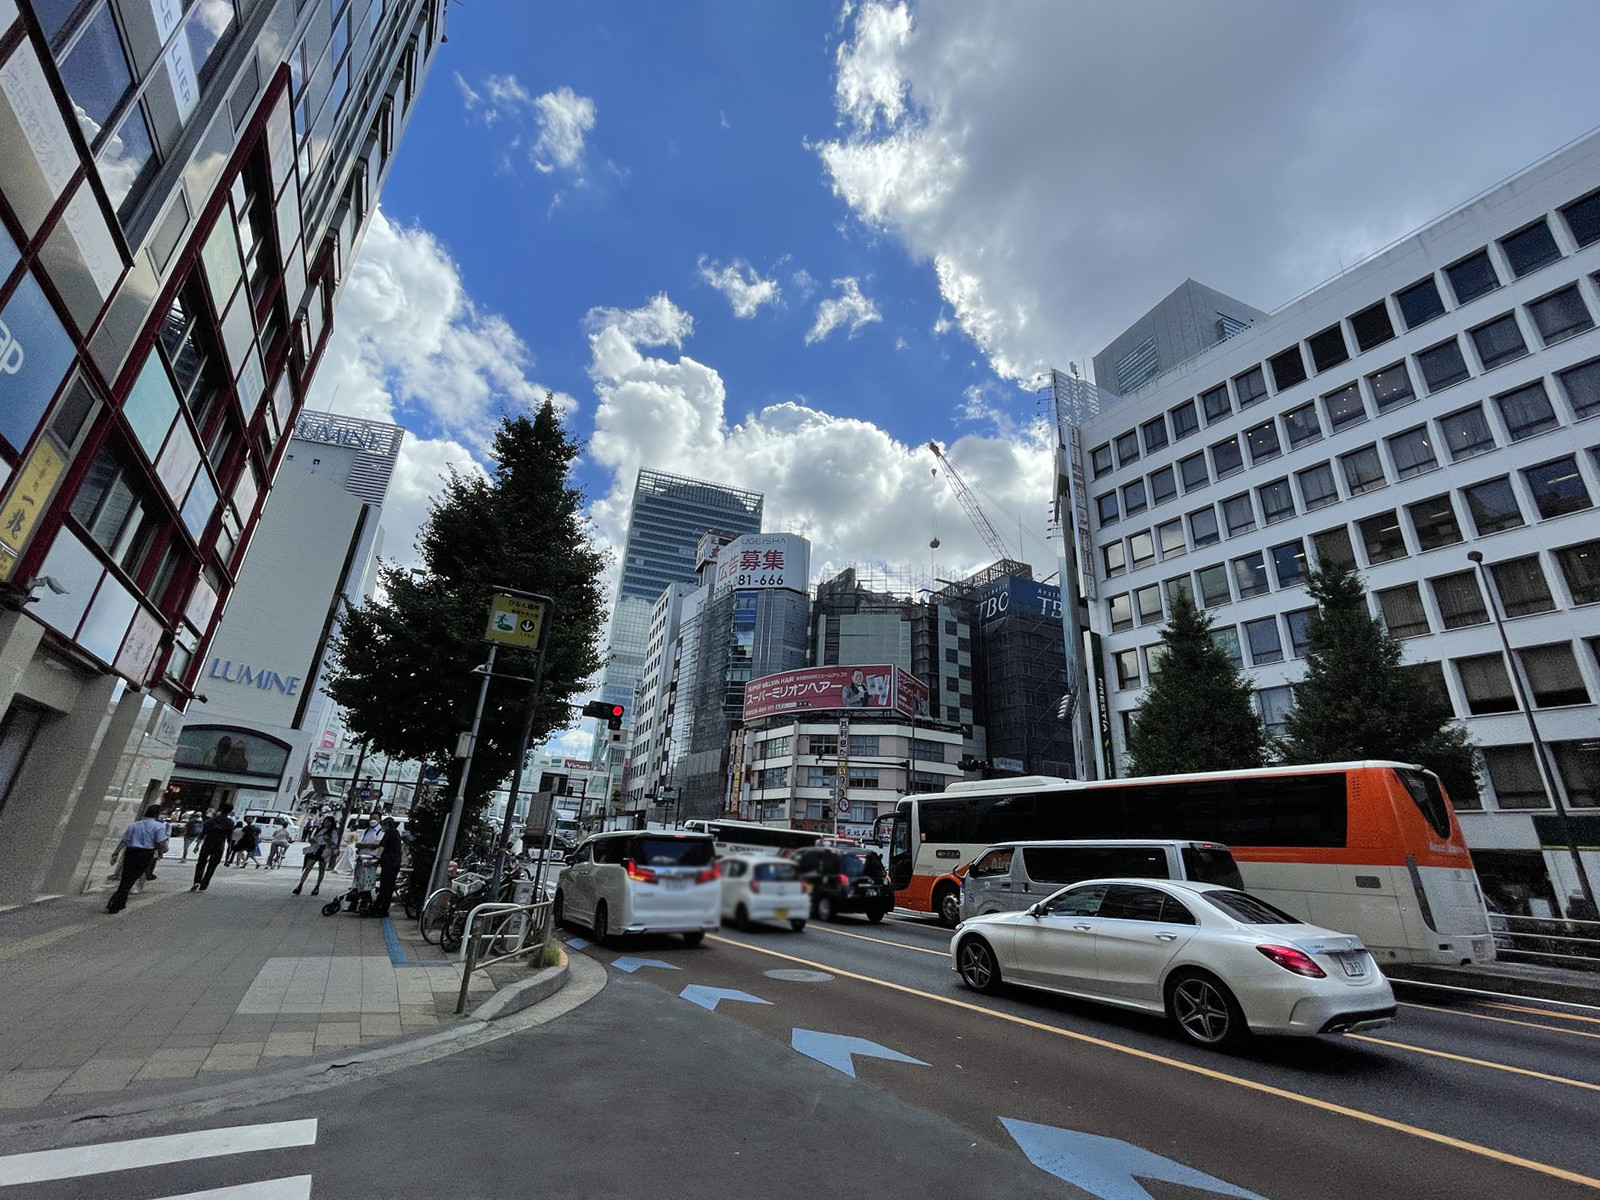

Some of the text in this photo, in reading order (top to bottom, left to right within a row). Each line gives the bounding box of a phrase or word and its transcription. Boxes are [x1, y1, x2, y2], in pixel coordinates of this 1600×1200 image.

[299, 421, 381, 450] UMINE
[976, 591, 1009, 618] TBC
[1037, 596, 1063, 618] TB
[208, 657, 301, 696] LUMINE
[780, 675, 795, 684] HAIR
[746, 681, 843, 705] スーパーミリオンヘアー
[1097, 677, 1110, 733] PRESTIA
